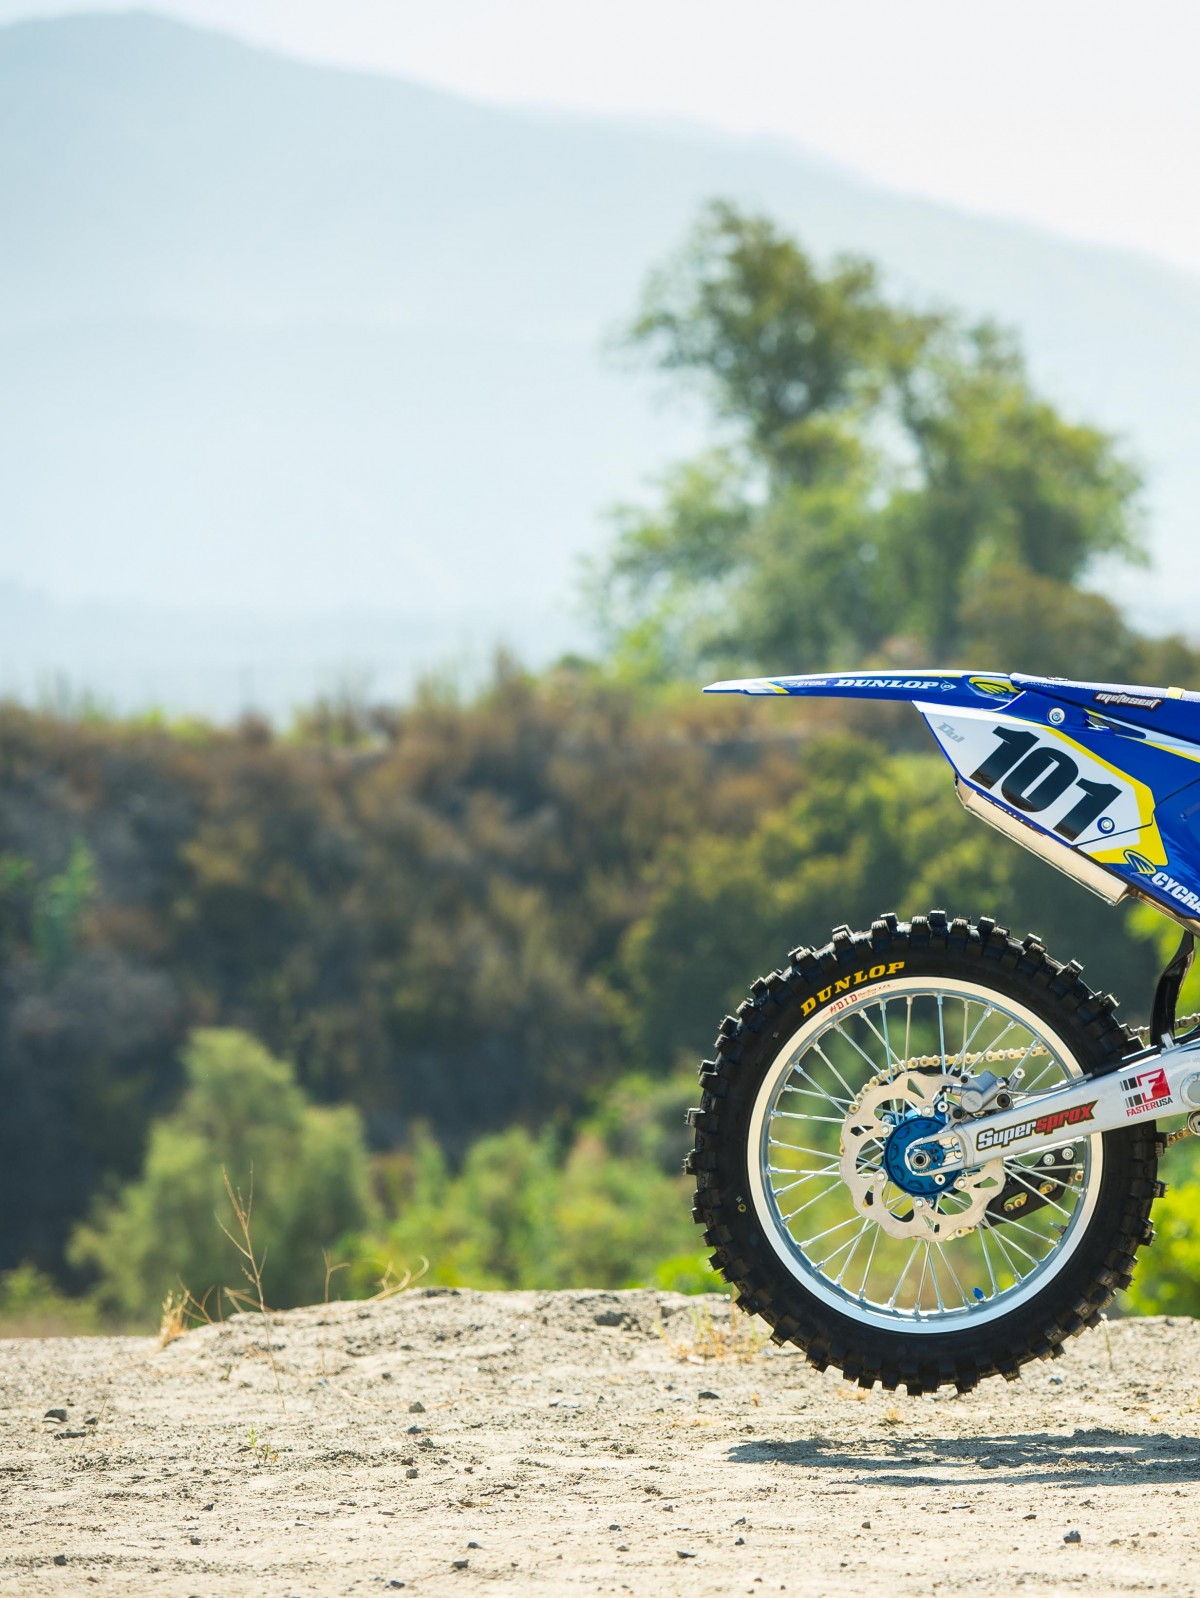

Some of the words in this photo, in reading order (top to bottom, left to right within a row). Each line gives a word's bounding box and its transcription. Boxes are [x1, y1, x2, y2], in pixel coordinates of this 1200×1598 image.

[834, 678, 939, 690] DUNLOP
[969, 725, 1123, 842] 101
[799, 961, 905, 1017] DUNLOP
[1126, 1096, 1173, 1117] FASTERUSA
